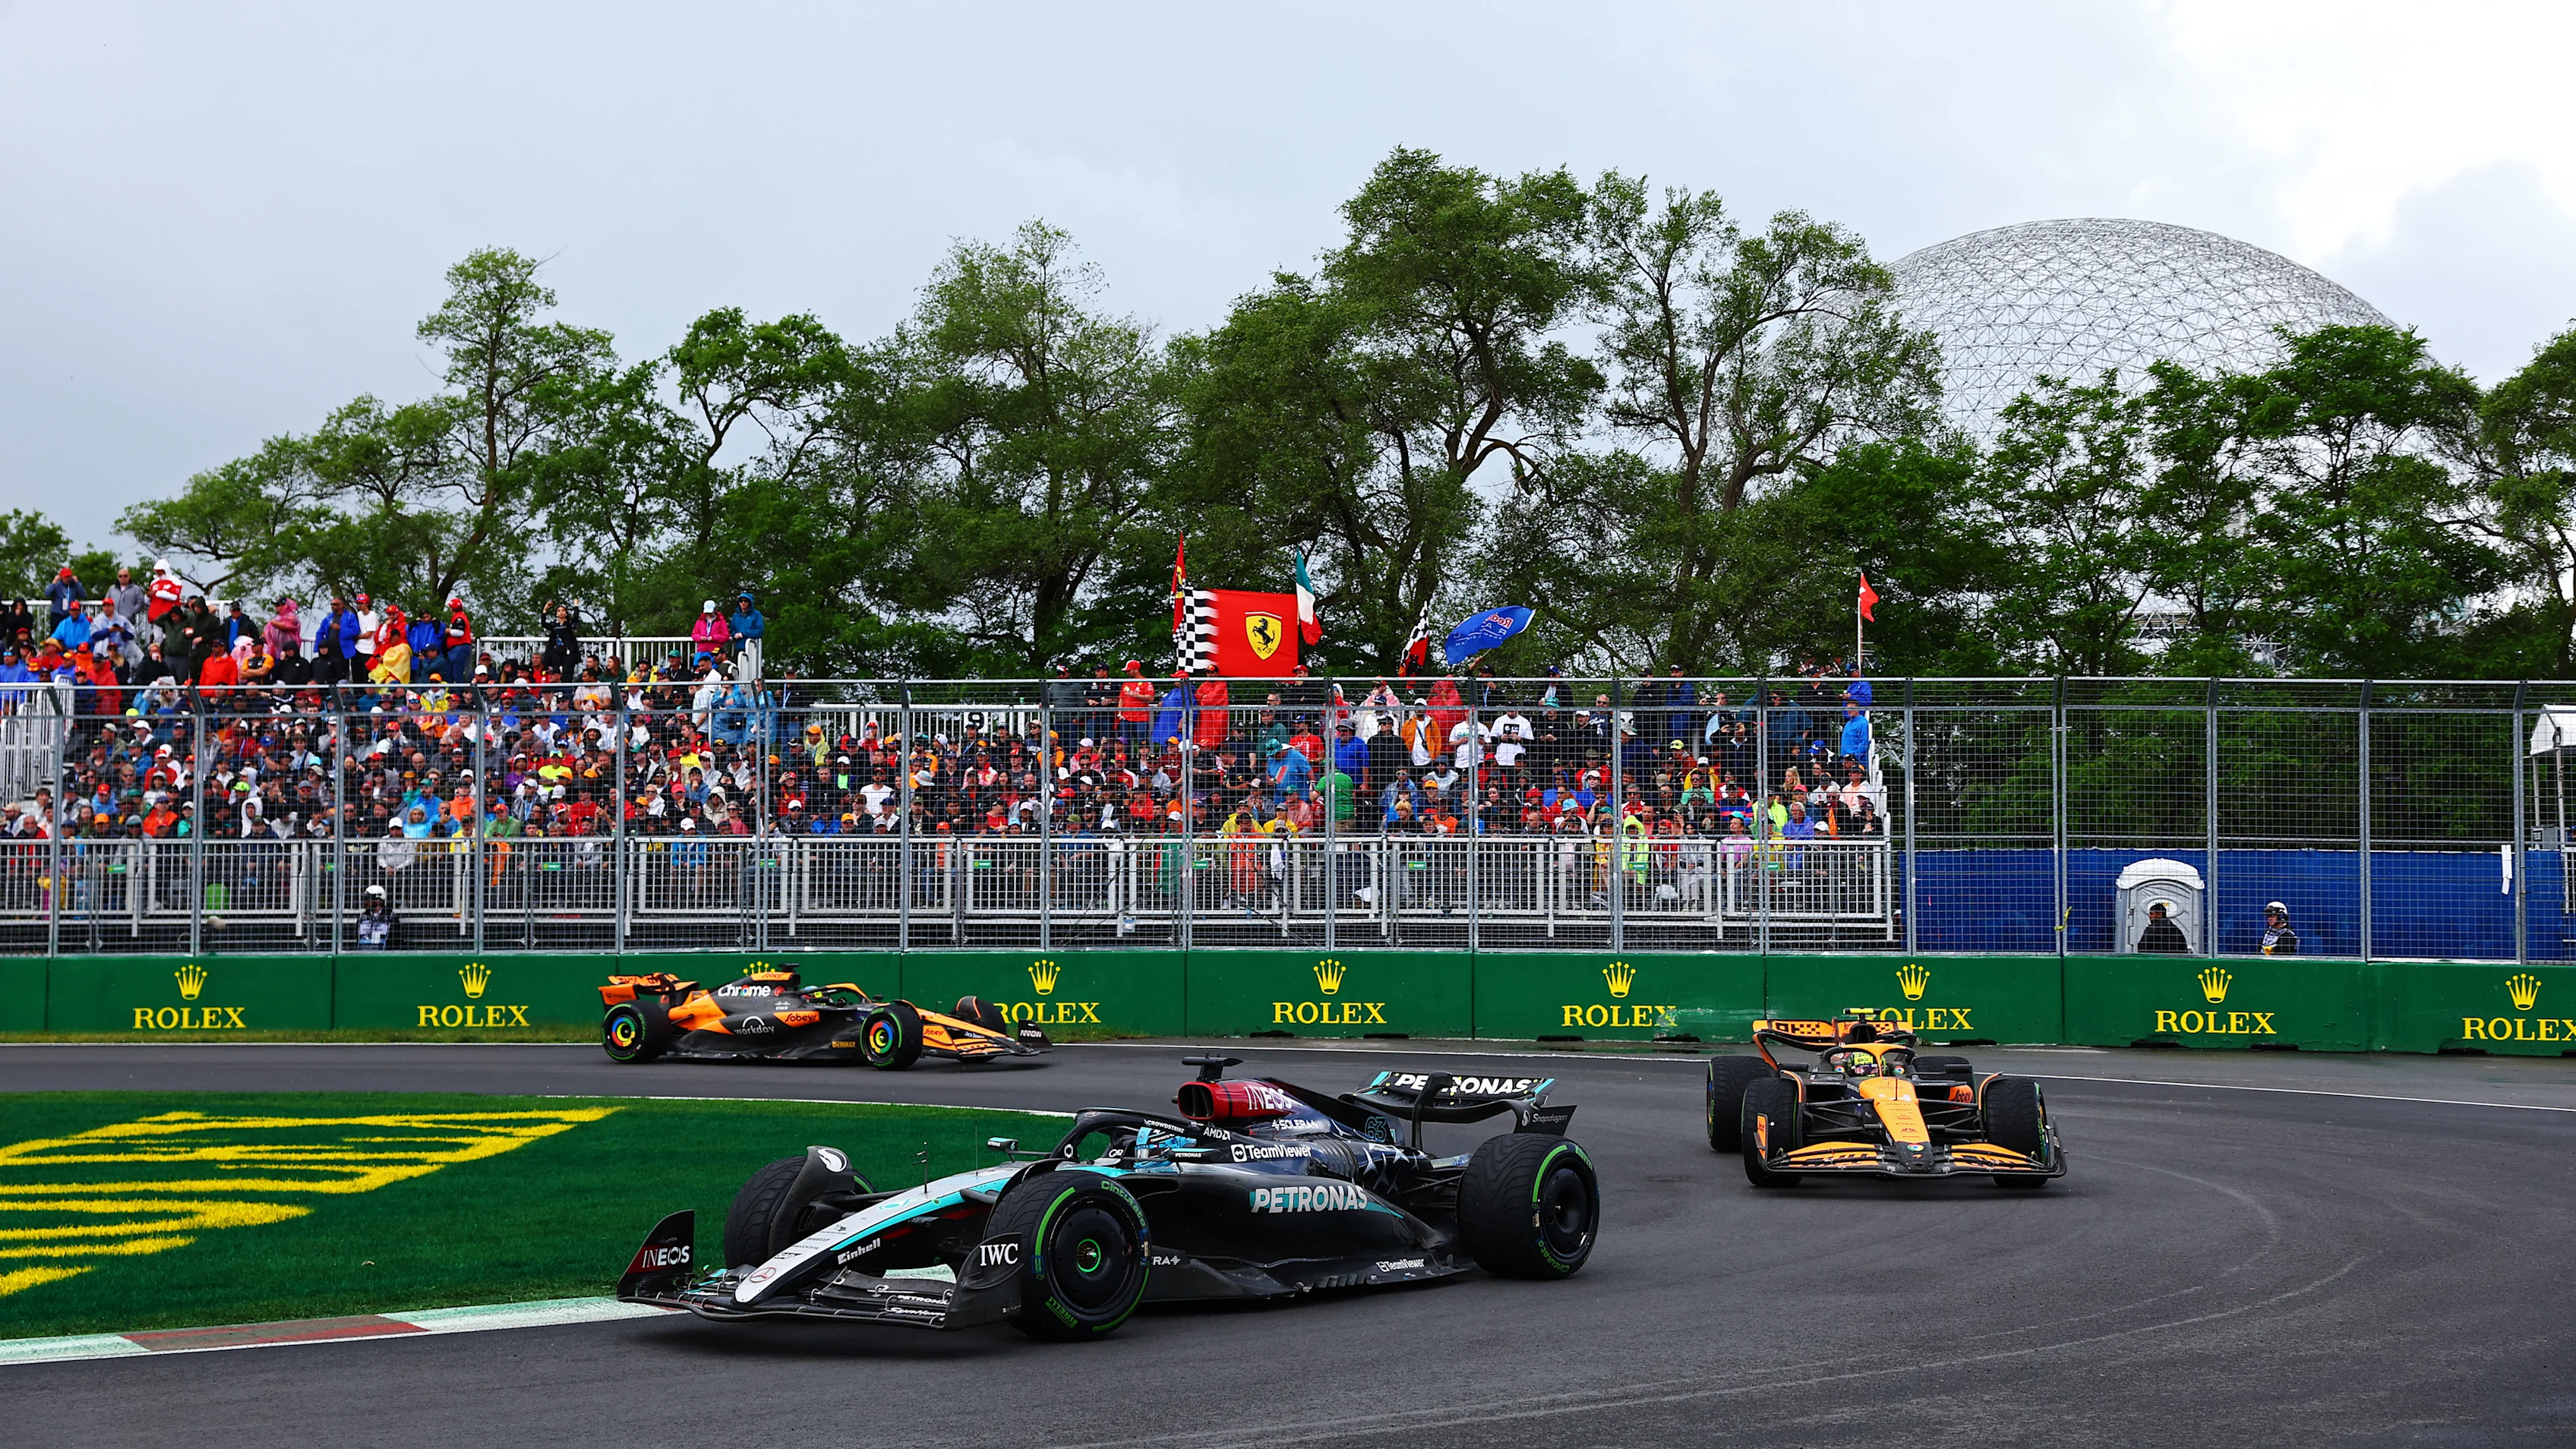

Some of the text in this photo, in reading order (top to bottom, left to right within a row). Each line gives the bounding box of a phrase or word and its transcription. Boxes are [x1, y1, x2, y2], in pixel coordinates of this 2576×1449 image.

[968, 712, 984, 730] 9
[133, 1007, 246, 1029] ROLEX
[418, 1005, 529, 1027] ROLEX
[784, 1012, 817, 1022] Sobeys
[1273, 1002, 1385, 1024] ROLEX
[1561, 1004, 1678, 1027] ROLEX
[1870, 1007, 1974, 1030] OLEX
[2155, 1010, 2277, 1034] ROLEX
[734, 1025, 775, 1035] workday
[1395, 1073, 1530, 1094] PERONAS
[1243, 1085, 1293, 1110] INEOS
[1147, 1119, 1185, 1134] CROWDSTRIKE
[1279, 1119, 1312, 1130] SOLERA
[1365, 1116, 1388, 1143] 63
[1532, 1113, 1568, 1125] Snapdragon
[1203, 1126, 1223, 1139] AMD
[1246, 1144, 1312, 1160] TeamViewer
[1101, 1180, 1146, 1227] Cinturato
[1252, 1185, 1368, 1214] PETRONAS
[642, 1245, 690, 1269] INEOS
[837, 1237, 881, 1265] Einhell
[980, 1242, 1019, 1267] IWC
[1384, 1258, 1425, 1271] TeamViewer
[897, 1294, 949, 1305] PETRONA
